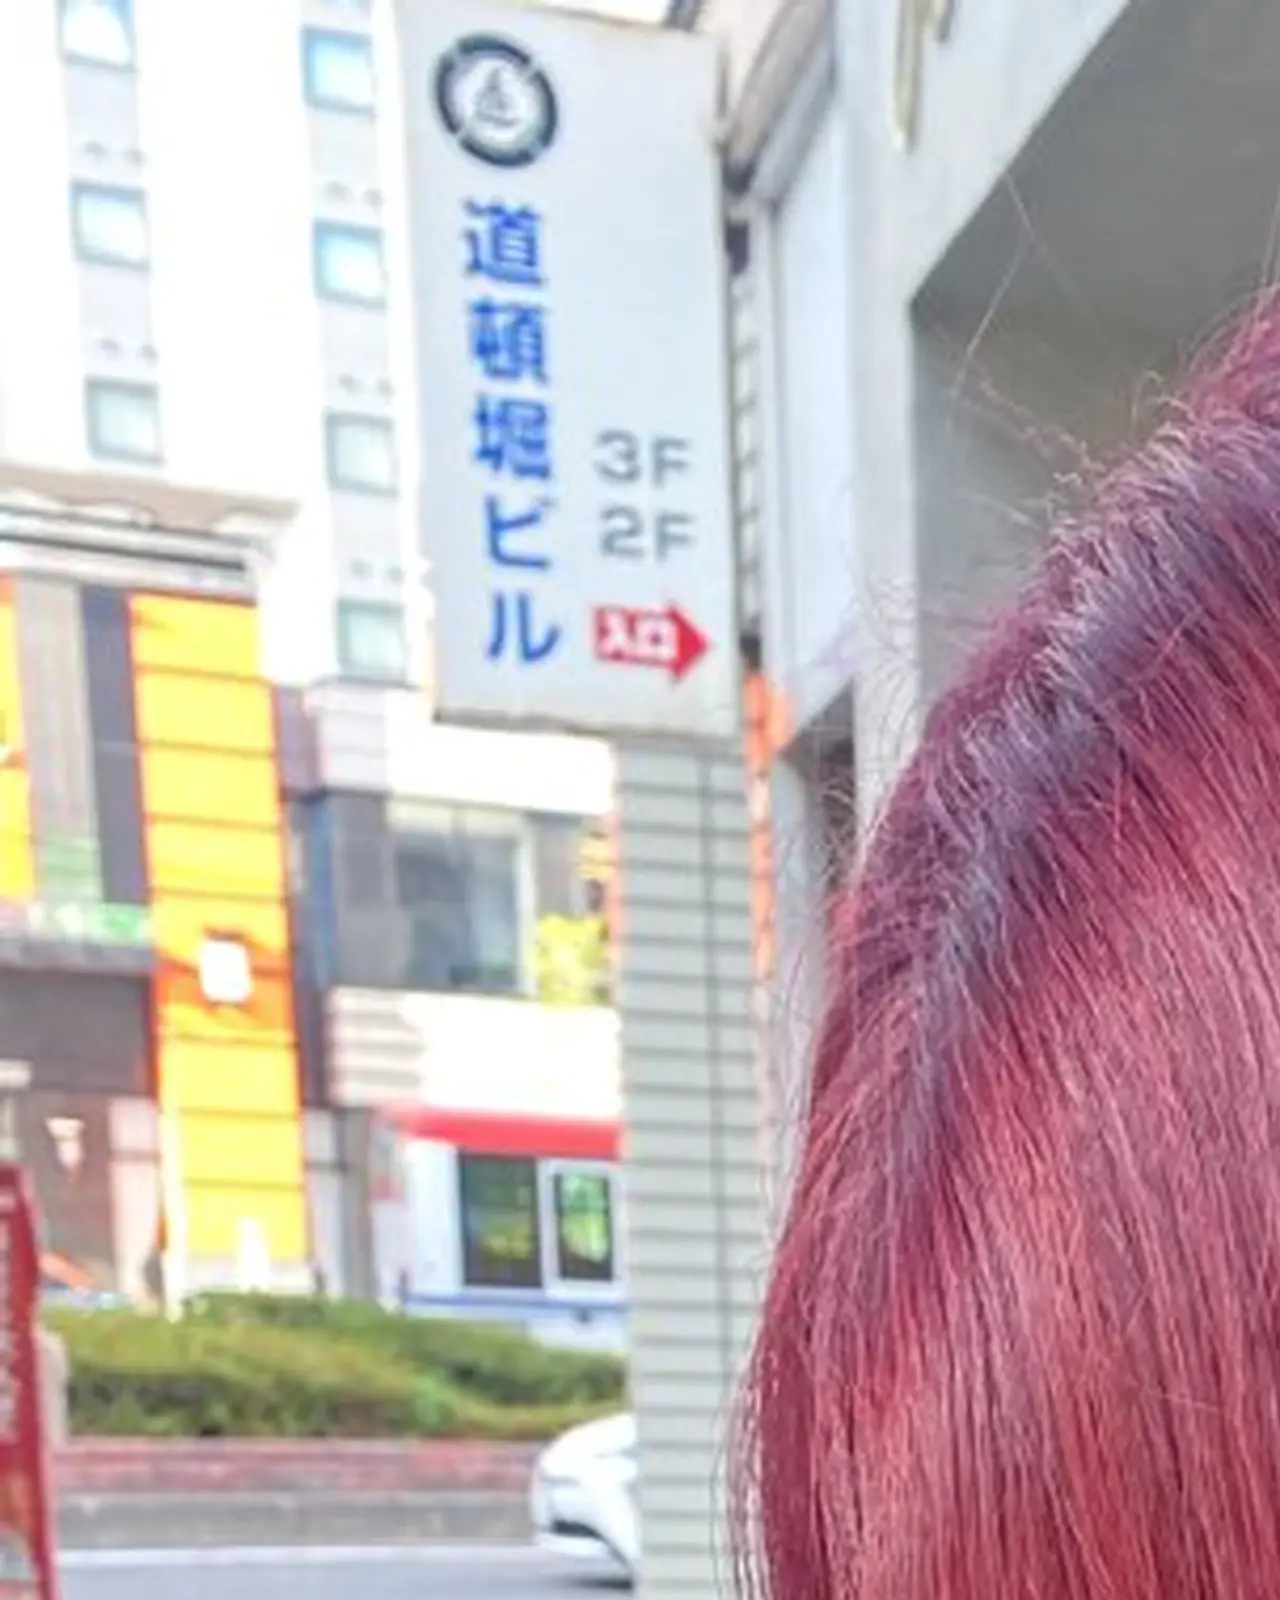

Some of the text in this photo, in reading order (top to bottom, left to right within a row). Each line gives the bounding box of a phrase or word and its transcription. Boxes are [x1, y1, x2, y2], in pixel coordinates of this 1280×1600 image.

[462, 197, 560, 664] 道頓堀ビル
[594, 430, 690, 489] 3F
[600, 505, 697, 561] 2F
[603, 609, 678, 660] 入口
